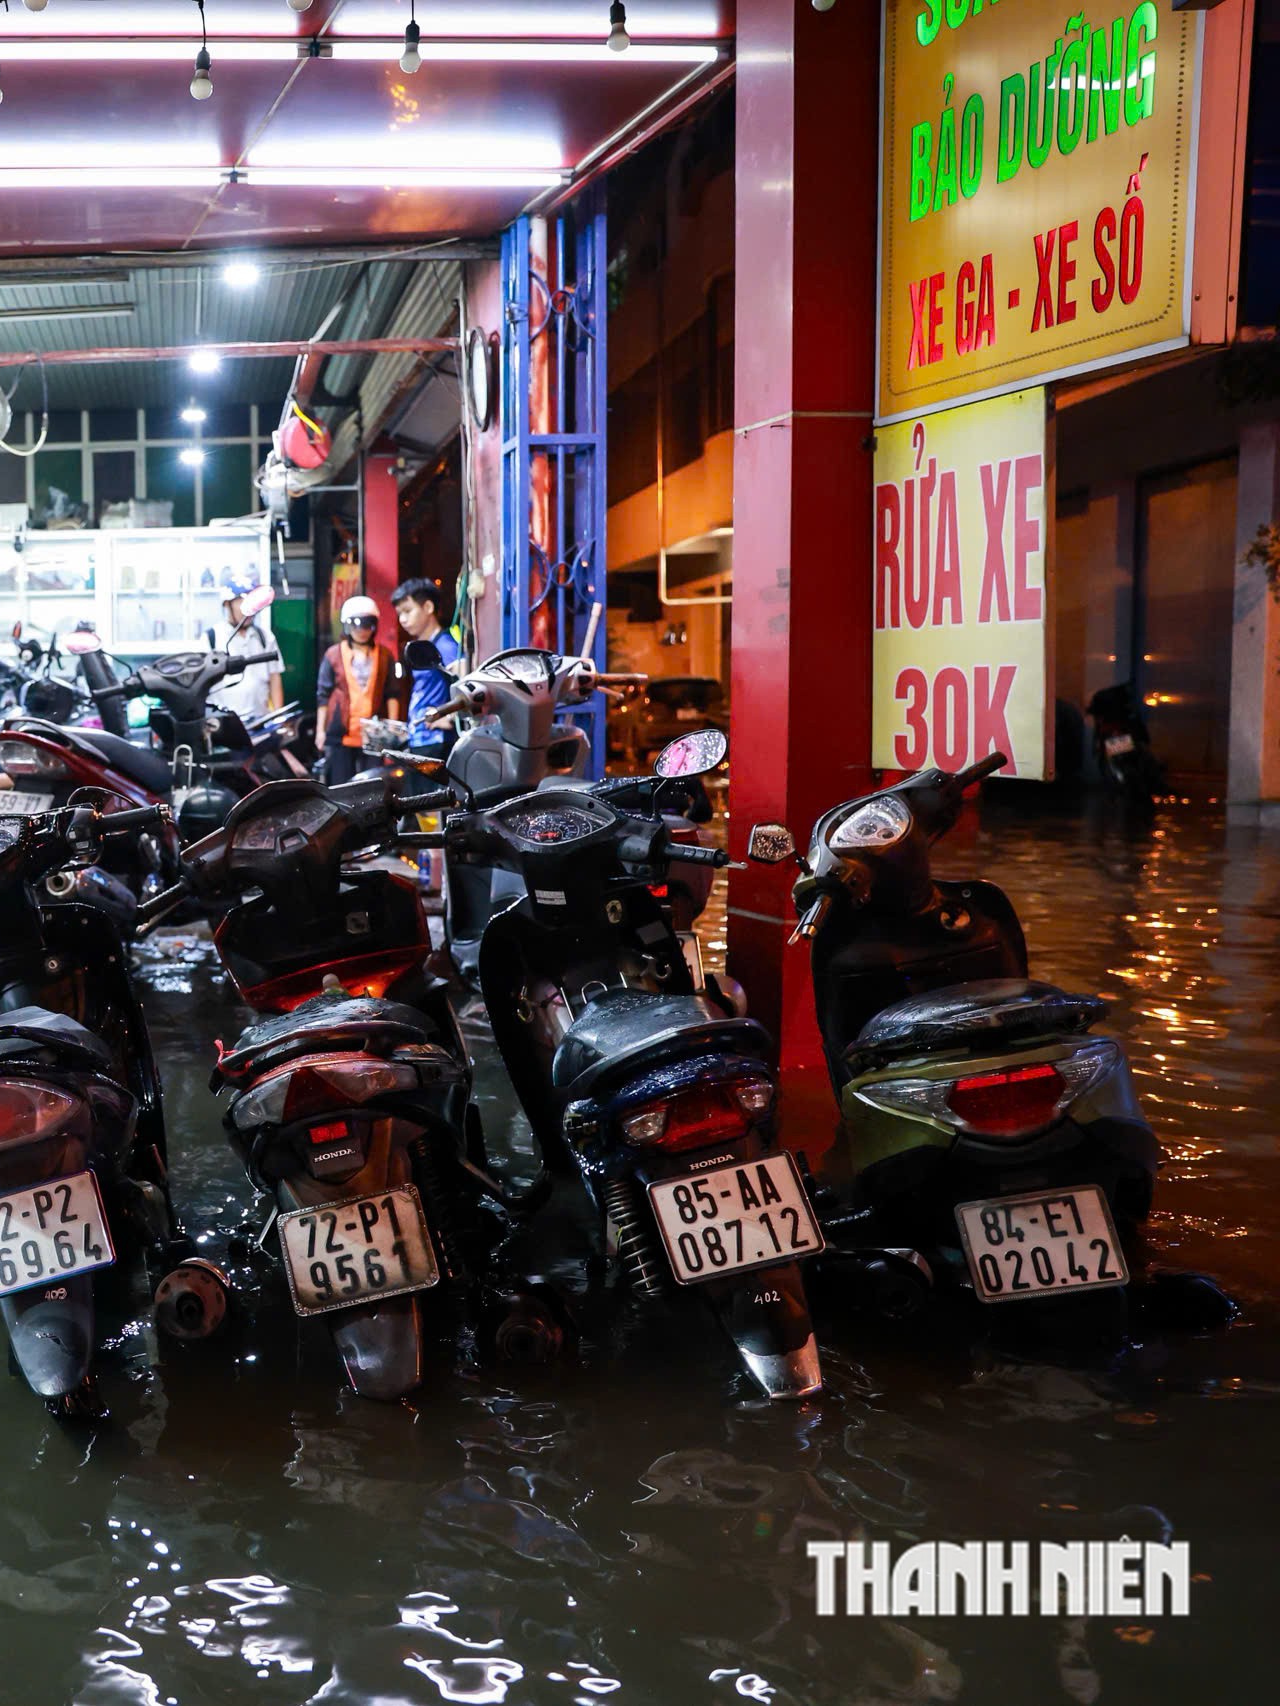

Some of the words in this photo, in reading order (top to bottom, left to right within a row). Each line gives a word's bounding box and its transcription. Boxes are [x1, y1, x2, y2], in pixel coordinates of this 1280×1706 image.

[908, 72, 985, 223] BẢO
[997, 1, 1159, 184] DƯỠNG
[907, 271, 946, 371] XE
[955, 253, 997, 357] GA
[1030, 220, 1079, 333] XE
[1091, 152, 1150, 314] SỐ
[876, 421, 963, 630] RỬA
[978, 454, 1042, 624] XE
[894, 665, 1018, 776] 30K
[314, 1148, 355, 1163] HONDA
[689, 1153, 735, 1171] HONDA
[672, 1164, 782, 1224] 85-AA
[980, 1195, 1085, 1246] 84-E1
[299, 1196, 401, 1258] 72-P1
[678, 1207, 810, 1273] 087.12
[309, 1240, 414, 1300] 9561
[978, 1239, 1118, 1293] 020.42
[754, 1290, 781, 1304] 402
